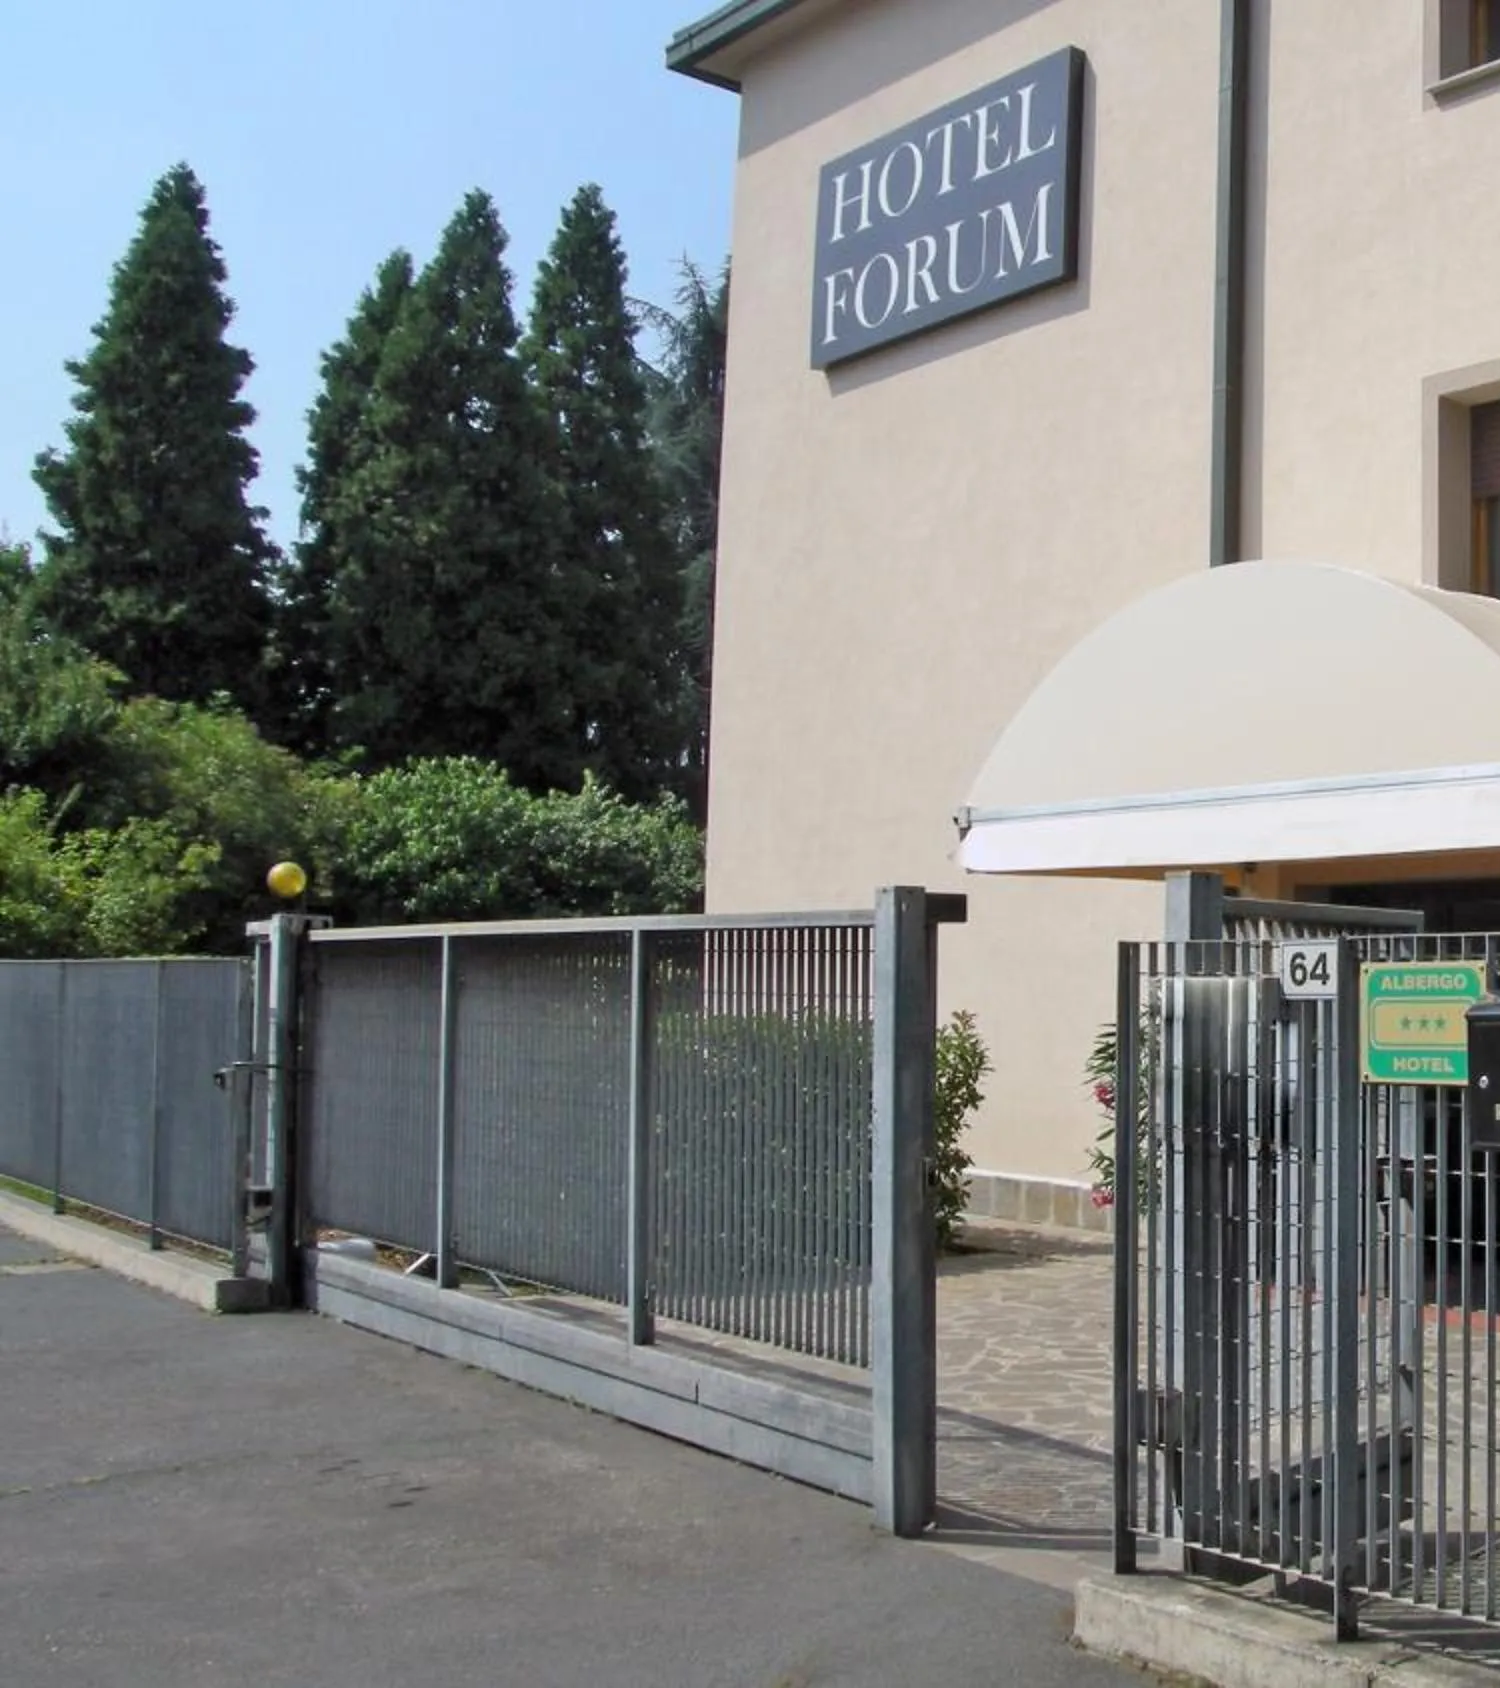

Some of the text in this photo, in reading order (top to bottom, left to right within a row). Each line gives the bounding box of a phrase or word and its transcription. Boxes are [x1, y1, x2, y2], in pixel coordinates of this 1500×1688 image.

[829, 82, 1055, 244] HOTEL
[820, 182, 1054, 345] FORUM
[1289, 952, 1330, 986] 64
[1380, 974, 1467, 990] ALBERGO
[1393, 1056, 1454, 1073] HOTEL
